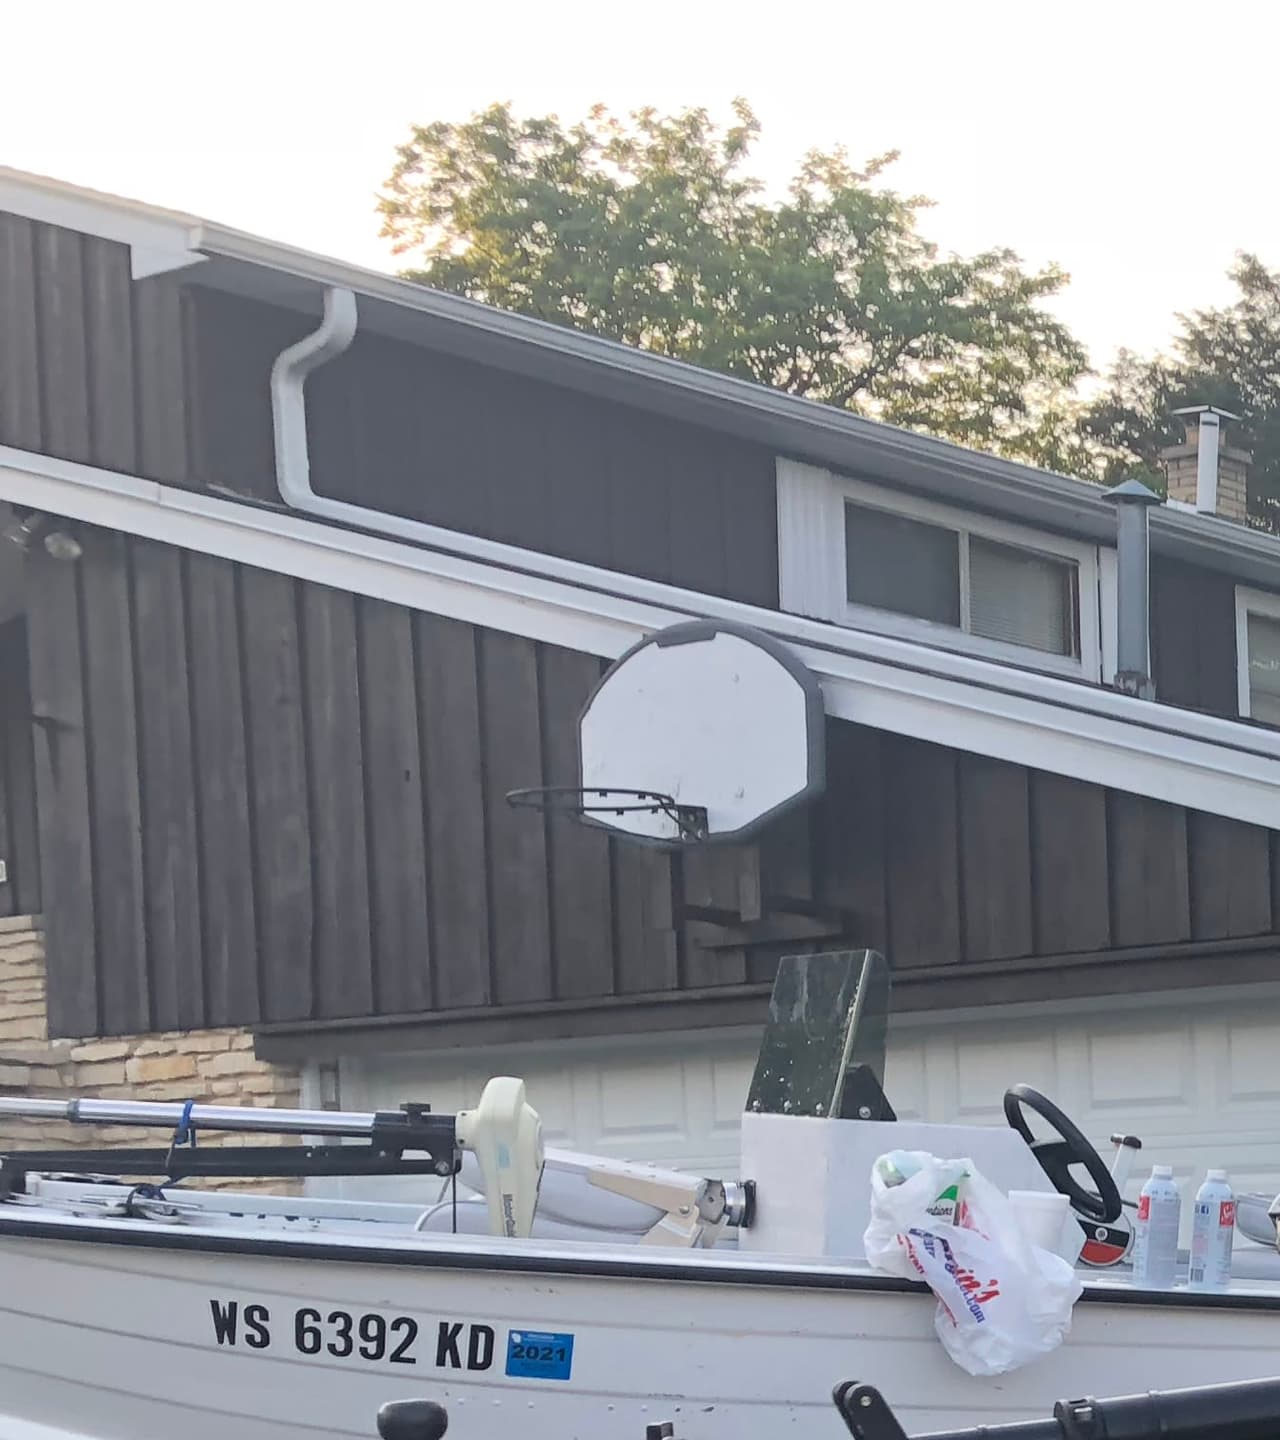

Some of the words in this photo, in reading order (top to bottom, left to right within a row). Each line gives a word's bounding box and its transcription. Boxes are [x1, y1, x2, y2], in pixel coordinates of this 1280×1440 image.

[210, 1300, 270, 1348] WS
[295, 1308, 418, 1364] 6392
[436, 1322, 495, 1371] KD
[511, 1345, 565, 1361] 2021
